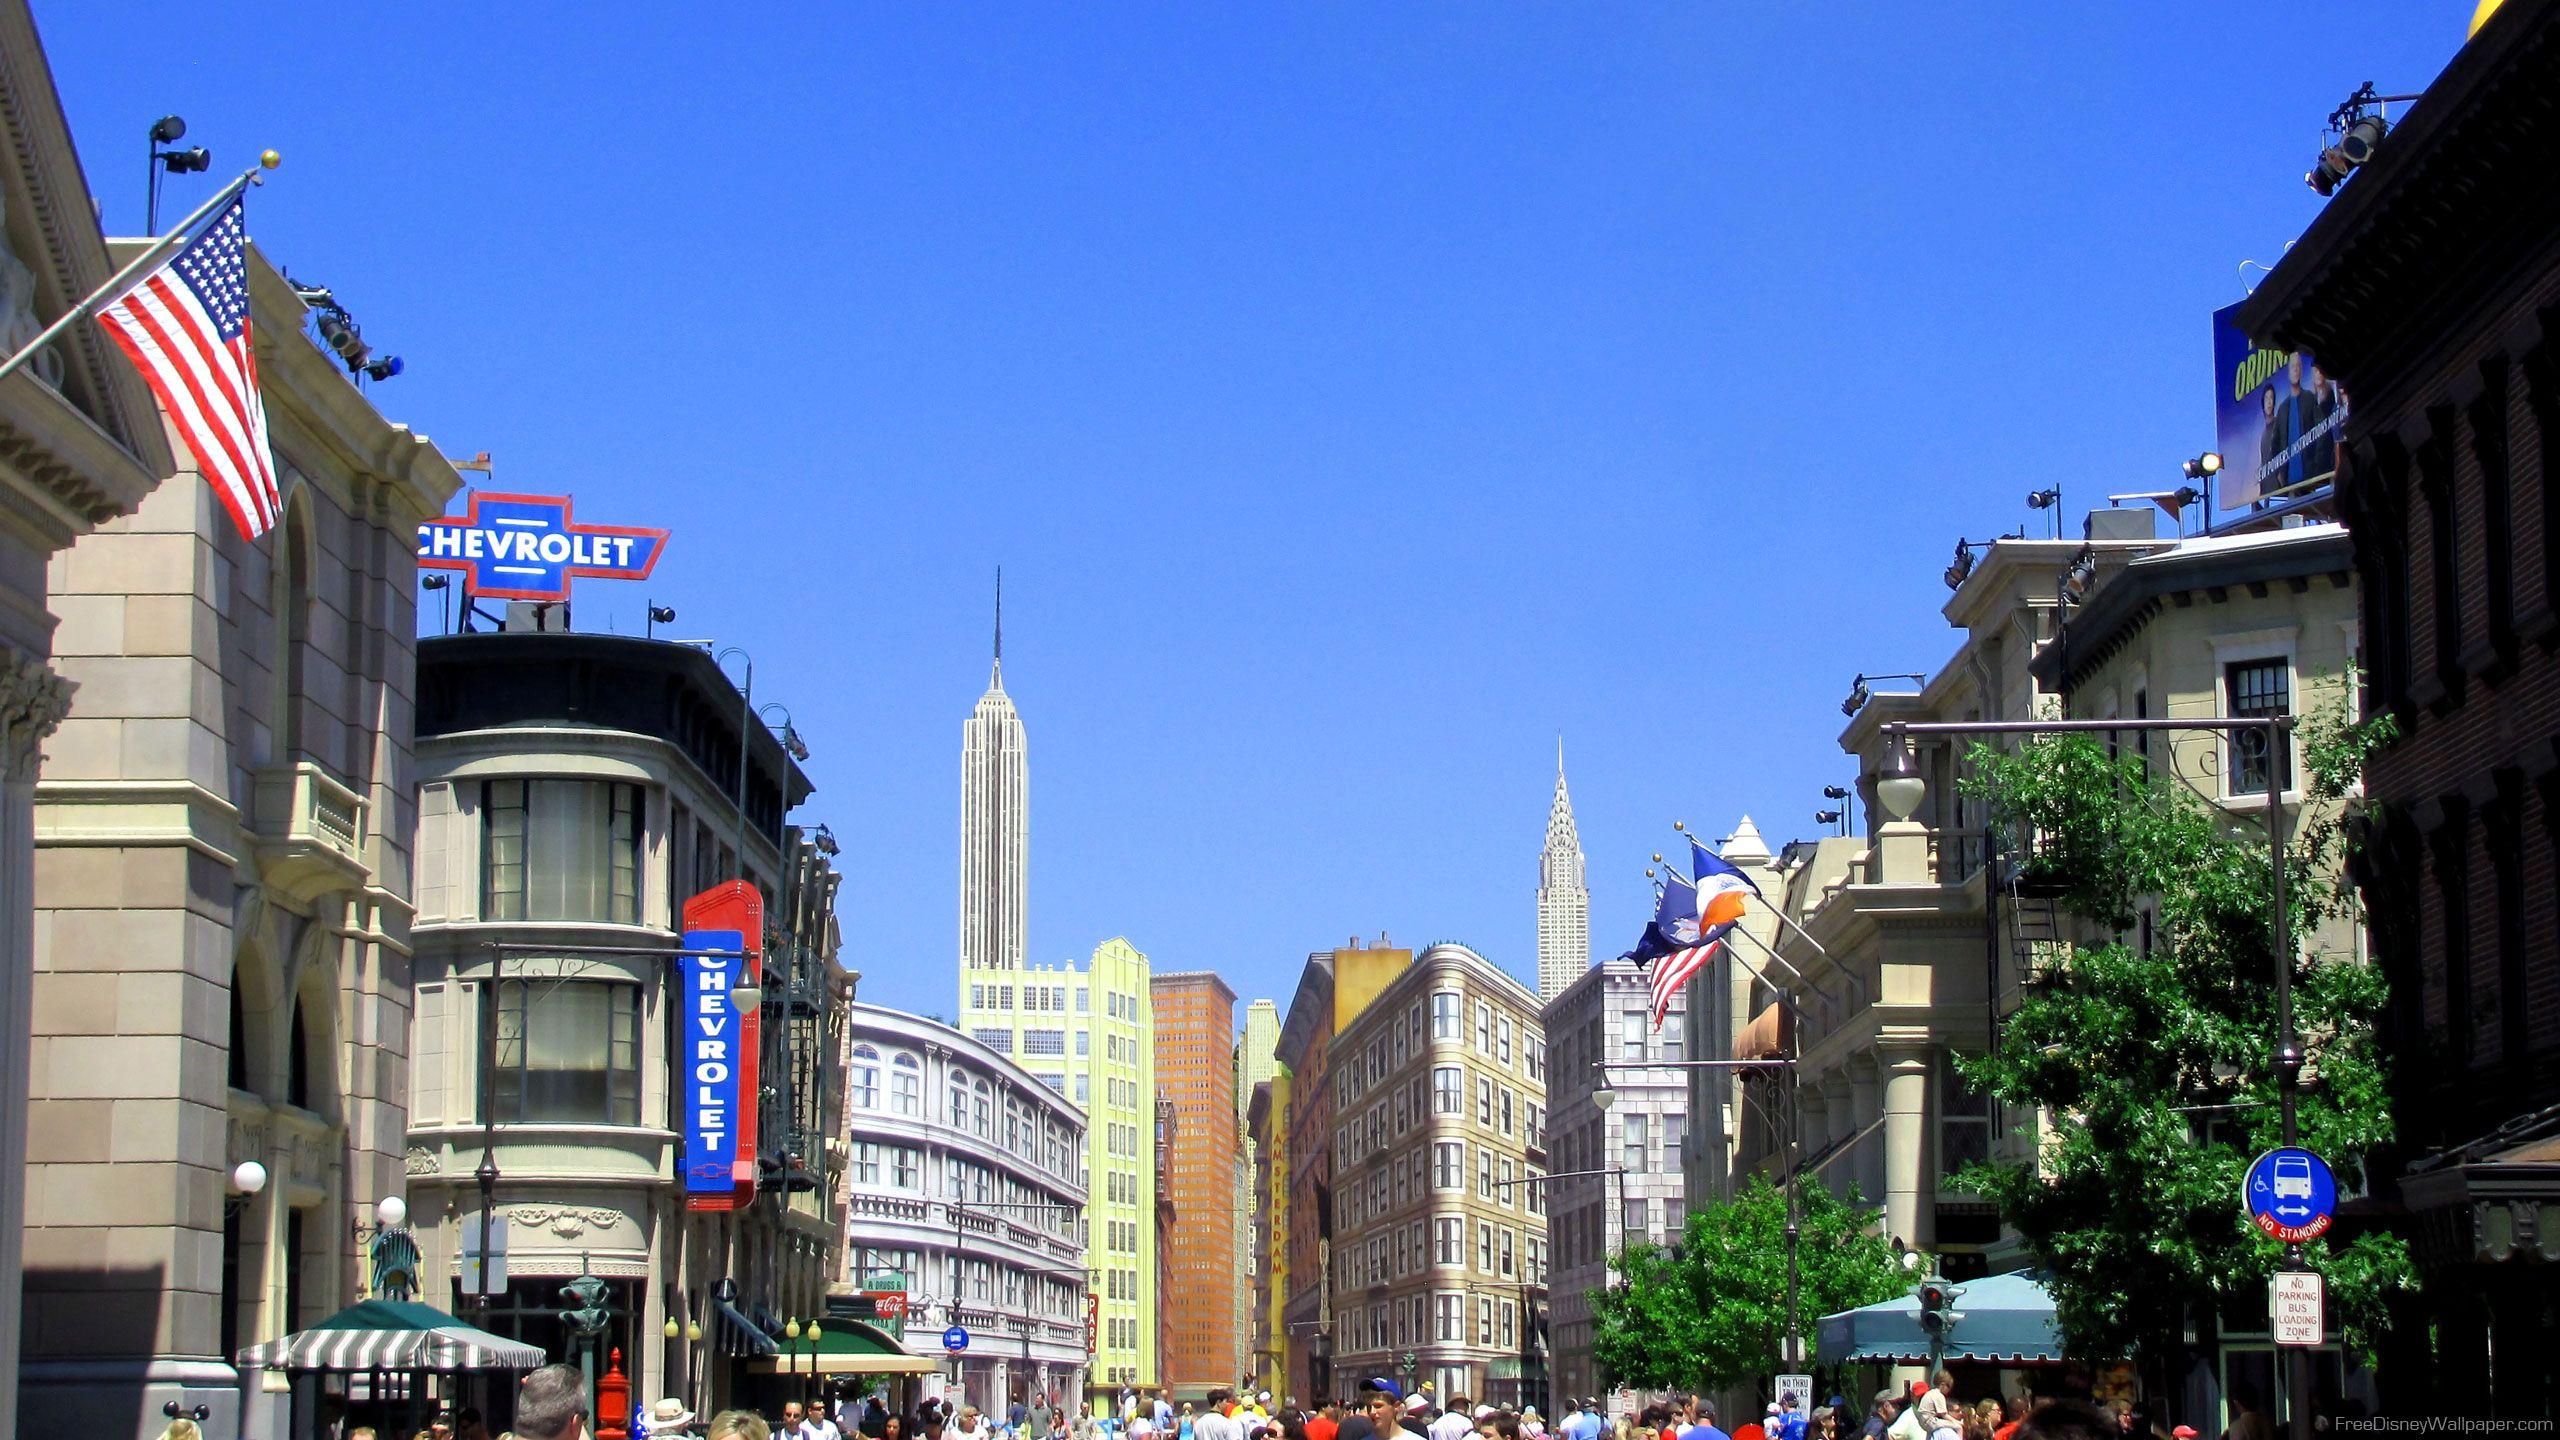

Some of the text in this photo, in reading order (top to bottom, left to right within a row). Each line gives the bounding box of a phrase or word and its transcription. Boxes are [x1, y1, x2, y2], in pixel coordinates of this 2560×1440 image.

[418, 525, 634, 566] CHEVROLET
[696, 948, 729, 1151] CHEVROLET
[1273, 1133, 1282, 1274] AMSTERDAM
[2258, 1213, 2328, 1239] NO STANDING
[2290, 1280, 2304, 1289] NO
[2278, 1291, 2317, 1301] PARKING
[2288, 1304, 2307, 1313] BUS
[2279, 1316, 2317, 1325] LOADING
[2286, 1327, 2311, 1336] ZONE
[1782, 1379, 1808, 1387] NO THRU
